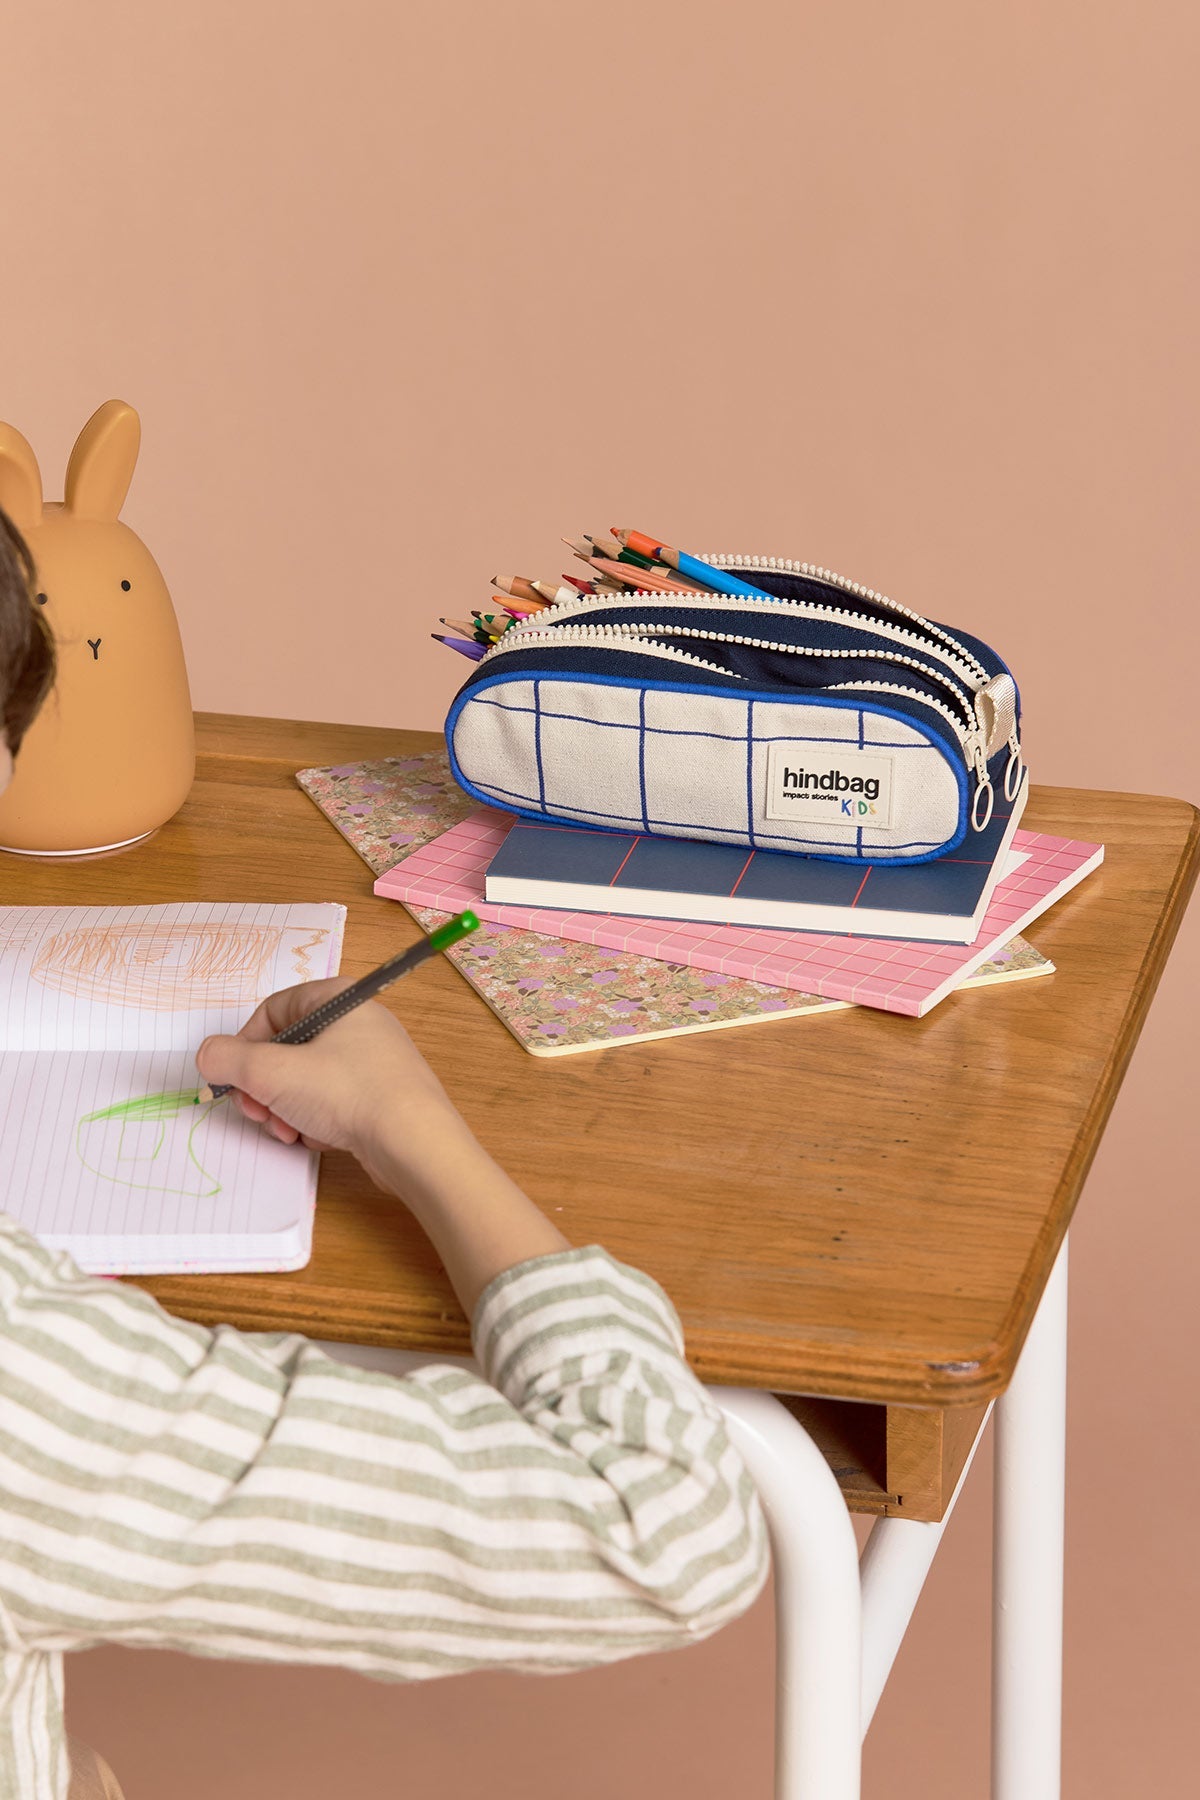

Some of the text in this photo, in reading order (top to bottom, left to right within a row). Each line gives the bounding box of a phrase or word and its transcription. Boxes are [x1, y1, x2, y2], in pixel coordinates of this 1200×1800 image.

[783, 767, 880, 800] hindbag
[782, 791, 839, 802] impact stories
[841, 799, 878, 818] KIDS
